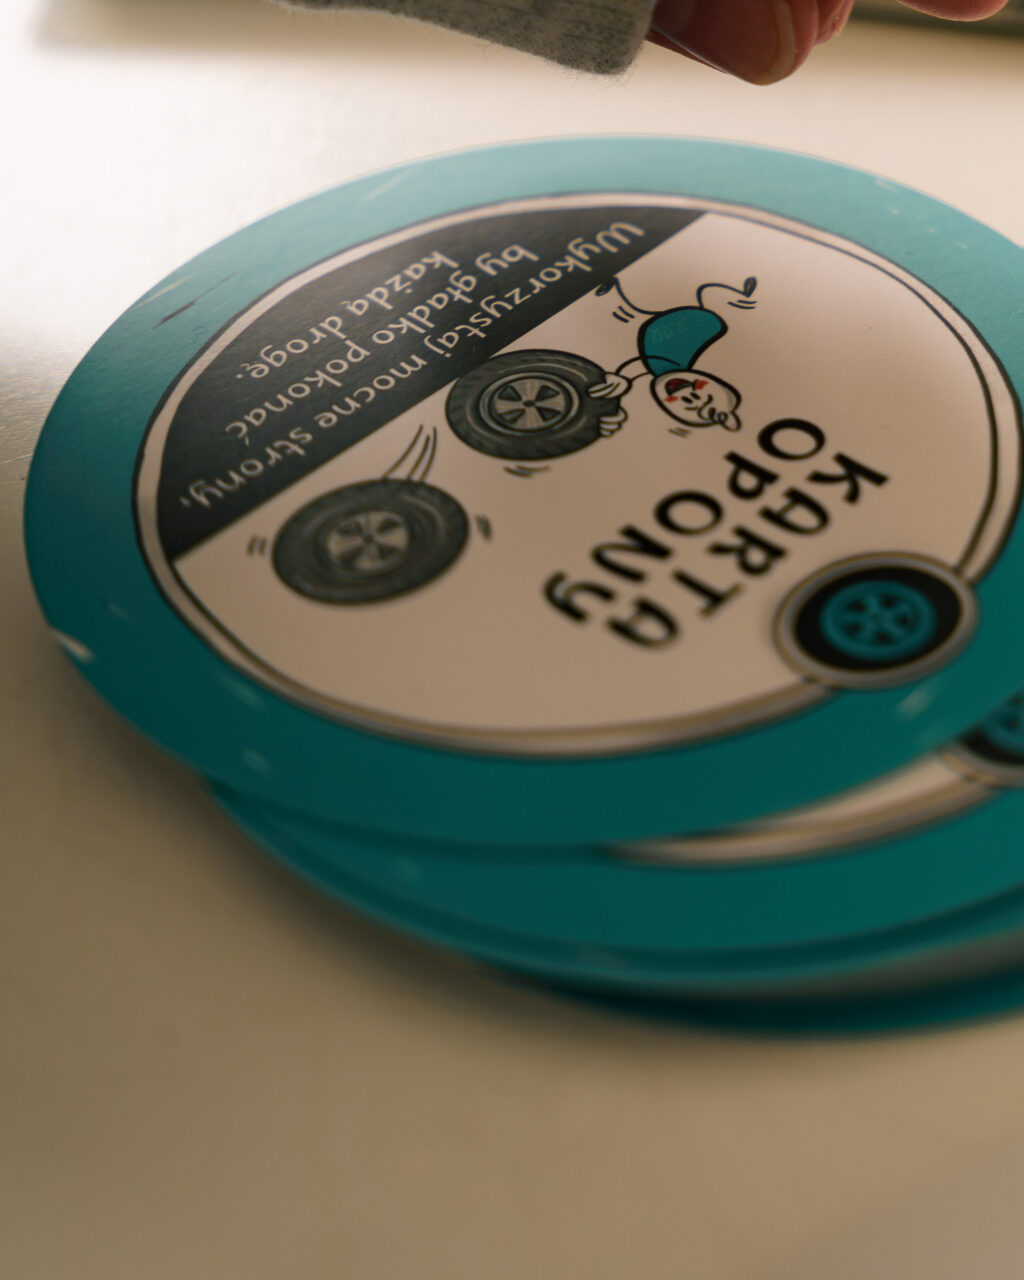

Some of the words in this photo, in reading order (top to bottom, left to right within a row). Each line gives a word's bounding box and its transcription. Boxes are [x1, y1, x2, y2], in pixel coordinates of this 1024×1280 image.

[346, 250, 460, 314] każdą
[424, 221, 645, 358] Wykorzystaj
[474, 244, 540, 276] by
[235, 312, 349, 380] drogę.
[371, 269, 477, 346] gładko
[224, 340, 371, 447] pokonać
[315, 354, 428, 429] mocne
[179, 427, 313, 509] strony,
[543, 418, 826, 623] OPONY
[607, 451, 890, 650] KARTA
